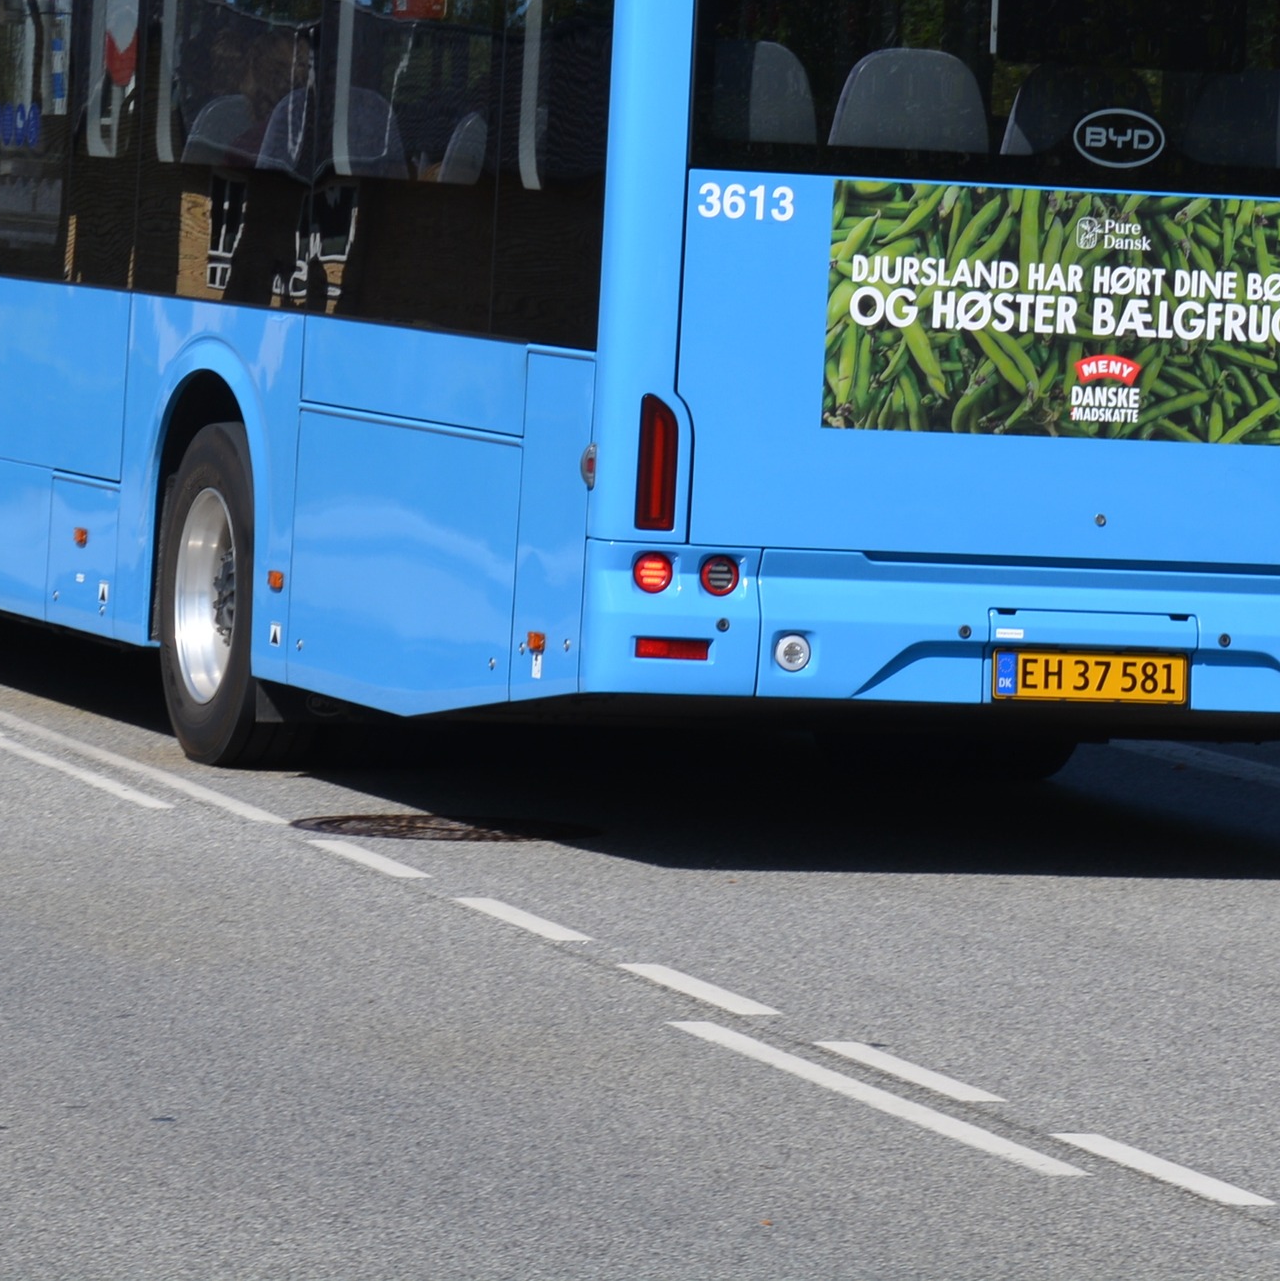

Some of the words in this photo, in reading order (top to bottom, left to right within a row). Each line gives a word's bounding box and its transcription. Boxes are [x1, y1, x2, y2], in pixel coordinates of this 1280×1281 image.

[1085, 126, 1155, 151] BYD
[698, 182, 794, 222] 3613
[1105, 219, 1141, 235] Pure
[1104, 234, 1151, 251] Dansk
[852, 255, 1019, 290] DJURSLAND
[1028, 263, 1083, 292] HAR
[1093, 265, 1166, 296] HØRT
[1174, 270, 1237, 299] DINE
[849, 286, 919, 328] OG
[932, 290, 1077, 334] HØSTER
[1081, 359, 1134, 378] MENY
[1070, 385, 1140, 408] DANSKE
[1071, 407, 1139, 423] MADSKATTE
[998, 676, 1012, 688] DK
[1021, 658, 1063, 689] EH
[1073, 660, 1112, 692] 37
[1120, 662, 1176, 694] 581
